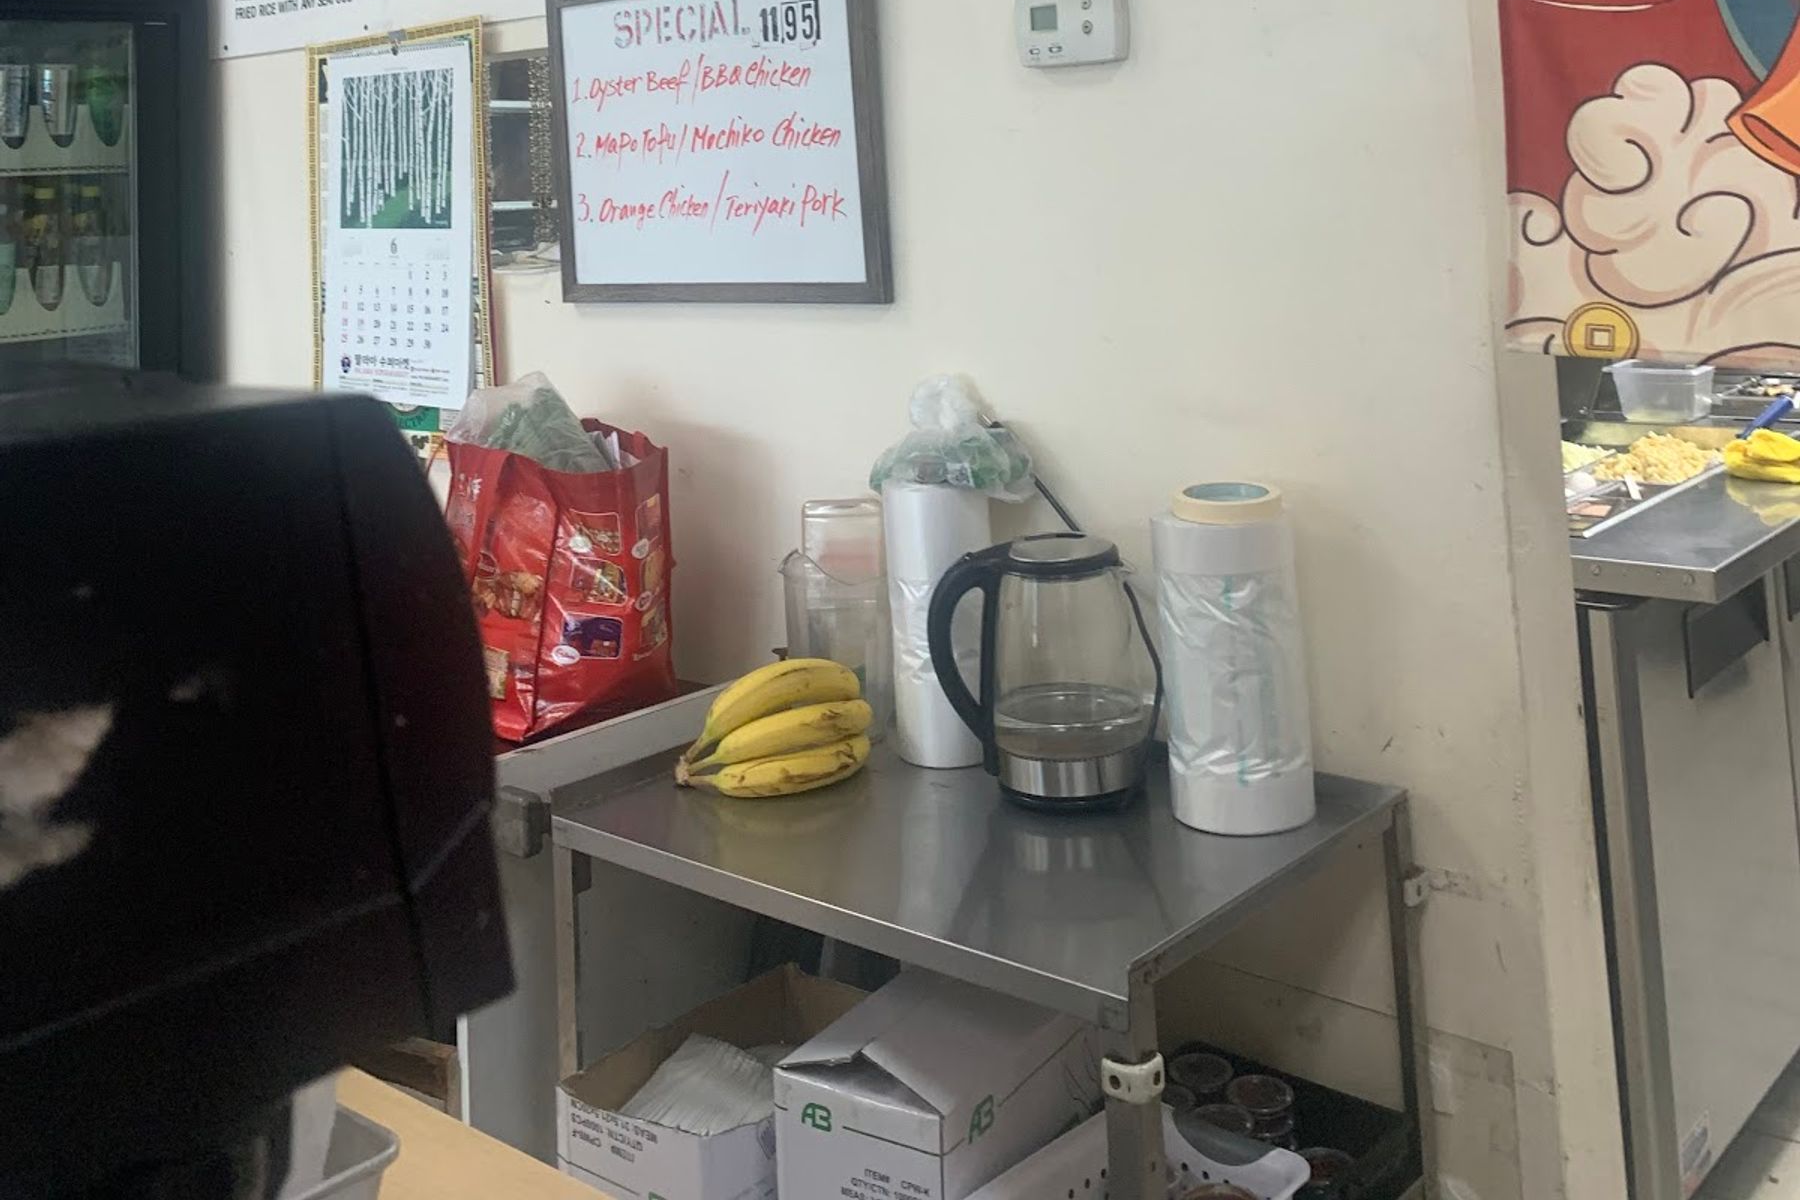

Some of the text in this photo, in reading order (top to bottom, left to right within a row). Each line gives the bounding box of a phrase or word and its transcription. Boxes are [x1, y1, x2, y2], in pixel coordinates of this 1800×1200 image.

[589, 74, 643, 112] Oyster
[745, 55, 812, 91] Chicken
[772, 111, 842, 149] Chicken
[599, 198, 655, 230] Orange
[800, 184, 848, 227] Pork
